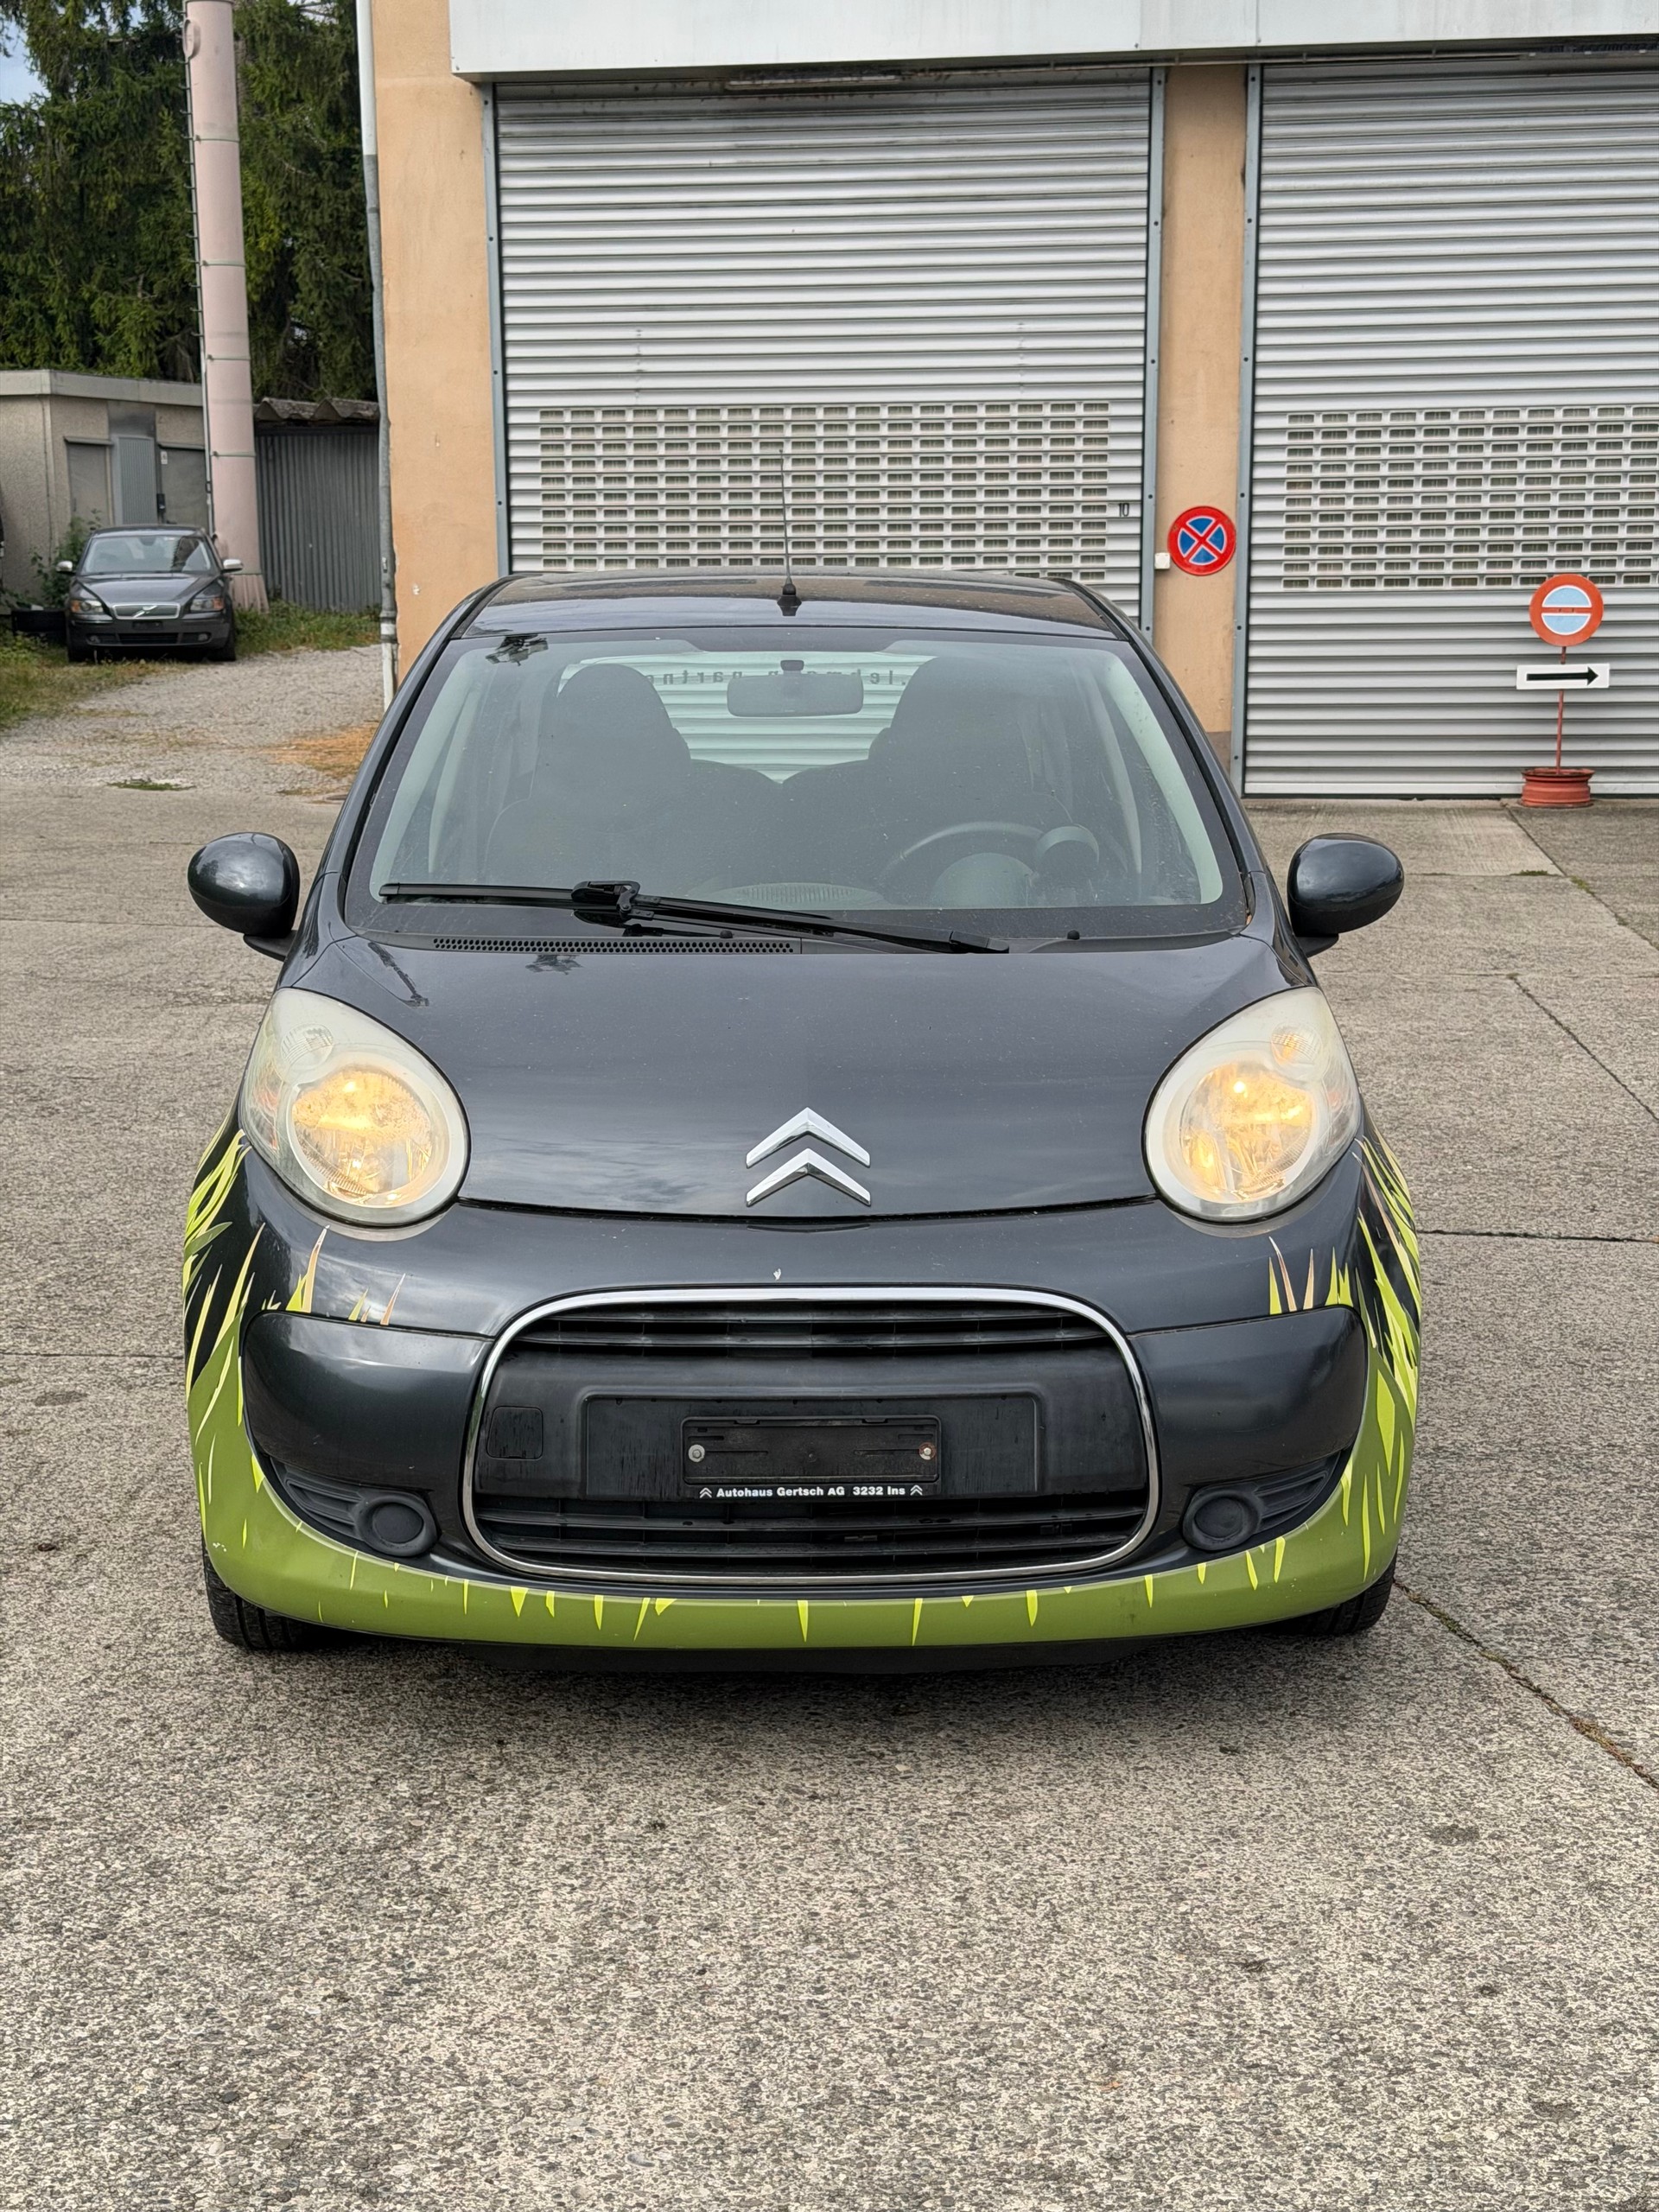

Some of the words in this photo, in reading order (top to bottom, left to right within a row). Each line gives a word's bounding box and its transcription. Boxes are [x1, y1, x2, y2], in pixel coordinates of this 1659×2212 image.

[1118, 503, 1130, 518] 10
[716, 1488, 772, 1497] Autohaus
[777, 1486, 823, 1497] Gertsch
[827, 1486, 845, 1497] AG
[852, 1485, 883, 1496] 3232
[887, 1485, 906, 1496] Ins
